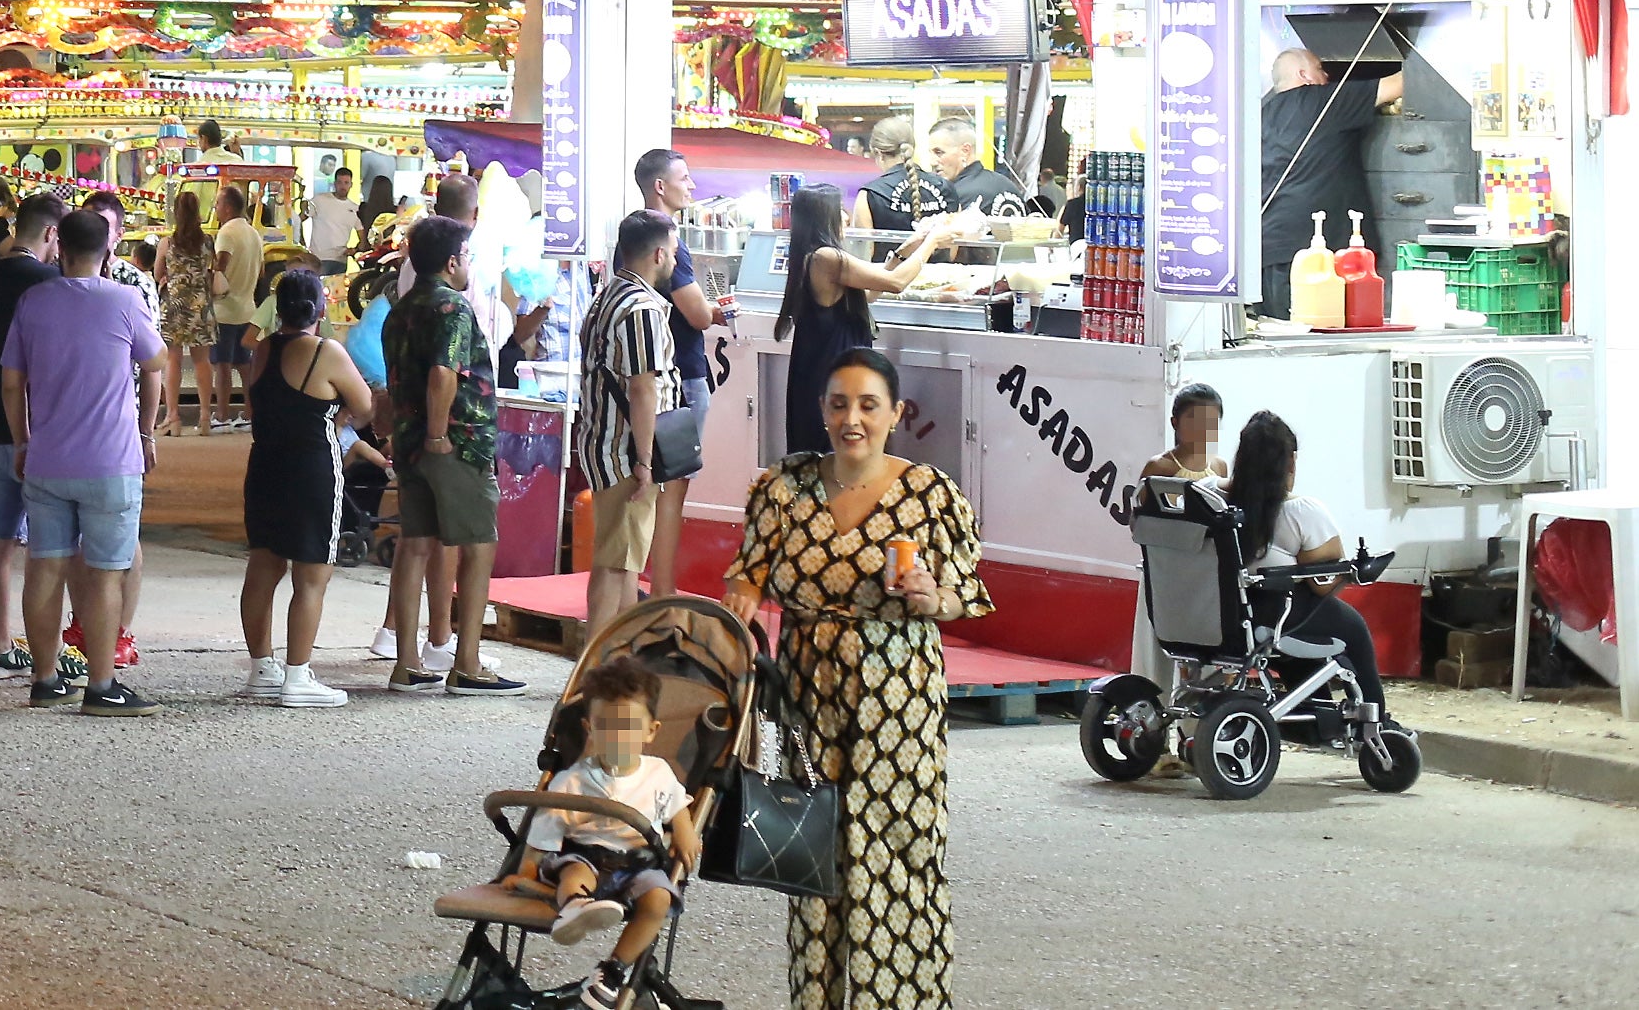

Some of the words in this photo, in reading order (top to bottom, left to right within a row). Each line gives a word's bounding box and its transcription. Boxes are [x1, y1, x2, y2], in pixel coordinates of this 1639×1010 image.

[890, 179, 912, 211] PATATA
[920, 201, 940, 212] AURI
[996, 364, 1135, 526] ASADAS
